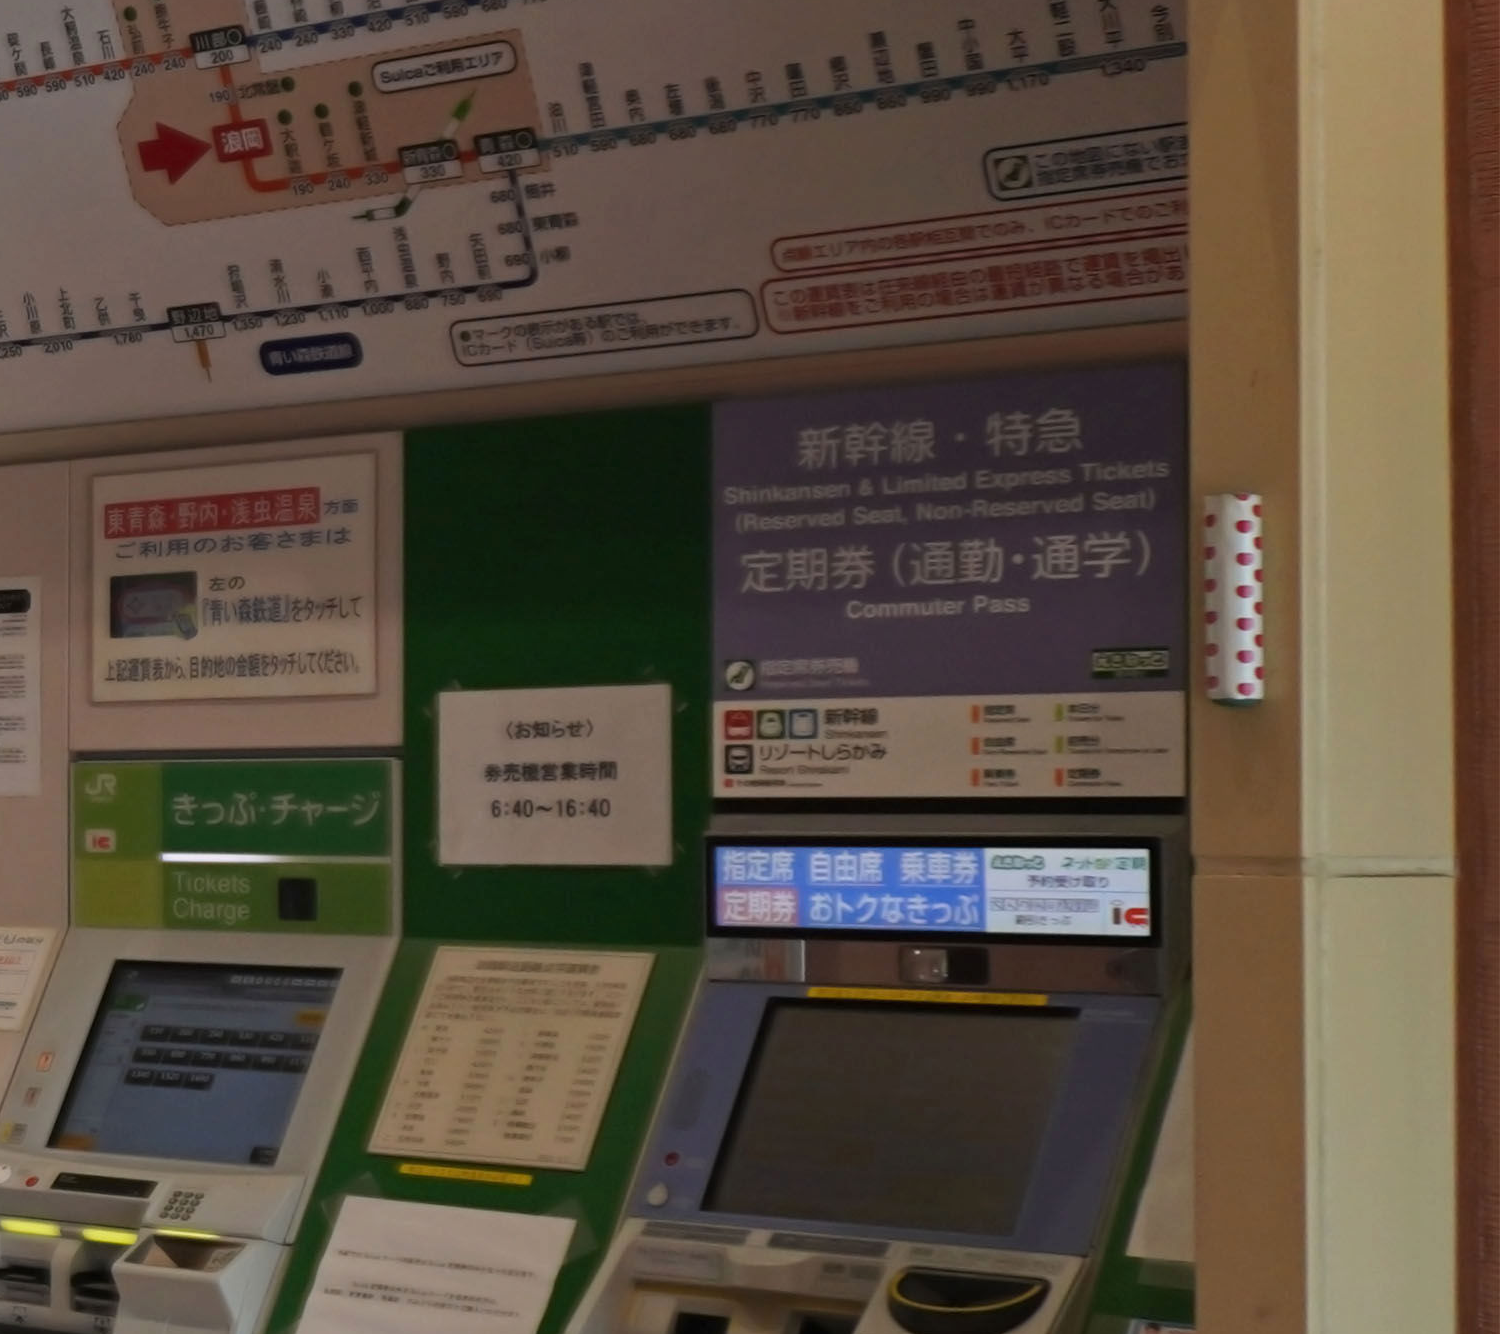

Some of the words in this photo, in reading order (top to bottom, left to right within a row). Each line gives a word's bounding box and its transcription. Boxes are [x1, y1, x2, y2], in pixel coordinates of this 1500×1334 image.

[368, 20, 392, 33] 420
[404, 12, 430, 26] 510
[295, 33, 319, 47] 240
[331, 26, 355, 39] 330
[96, 29, 115, 60] 石川
[259, 39, 282, 53] 240
[164, 57, 186, 71] 240
[210, 50, 233, 64] 200
[104, 68, 125, 82] 420
[134, 63, 155, 77] 240
[74, 74, 96, 87] 510
[17, 84, 37, 97] 590
[209, 90, 230, 102] 190
[919, 89, 950, 105] 990
[965, 81, 997, 98] 990
[749, 114, 778, 129] 770
[791, 107, 821, 123] 770
[221, 127, 263, 155] 浪岡
[553, 143, 578, 157] 510
[365, 173, 388, 185] 330
[420, 164, 445, 178] 330
[293, 184, 314, 195] 190
[328, 178, 350, 191] 240
[441, 291, 466, 307] 750
[361, 301, 395, 317] 1,000
[275, 311, 306, 326] 1,230
[183, 325, 214, 337] 1,470
[44, 340, 74, 354] 2,010
[797, 406, 1083, 469] 新幹線・特急
[724, 482, 851, 505] Shinkansen
[859, 482, 873, 497] &
[881, 473, 967, 497] Limited
[975, 468, 1071, 492] Express
[1079, 460, 1170, 482] Tickets
[107, 492, 317, 535] 東青森・野内・浅虫温泉
[324, 498, 359, 515] 方面
[736, 510, 845, 535] (Reserved
[915, 496, 1083, 522] Non-Reserved
[1091, 489, 1157, 512] Seat)
[115, 527, 353, 559] ご利用のお客さまは
[740, 531, 1154, 595] 定期券（通勤・通学）
[209, 575, 245, 591] 左の
[845, 600, 963, 620] Commuter
[972, 596, 1031, 615] Pass
[505, 718, 594, 740] 〈お知らせ〉
[759, 744, 887, 761] リゾートしらかみ
[483, 761, 618, 782] 券売機営業時間
[85, 773, 117, 796] JR
[172, 791, 380, 826] きっぷ・チャージ
[491, 799, 611, 818] 6:40～16:40
[723, 851, 795, 884] 指定席
[809, 851, 883, 883] 自由席
[900, 850, 979, 885] 乗車券
[171, 872, 250, 893] Tickets
[172, 898, 249, 925] Charge
[724, 891, 796, 923] 定期券
[809, 893, 979, 925] おトクなきっぷ
